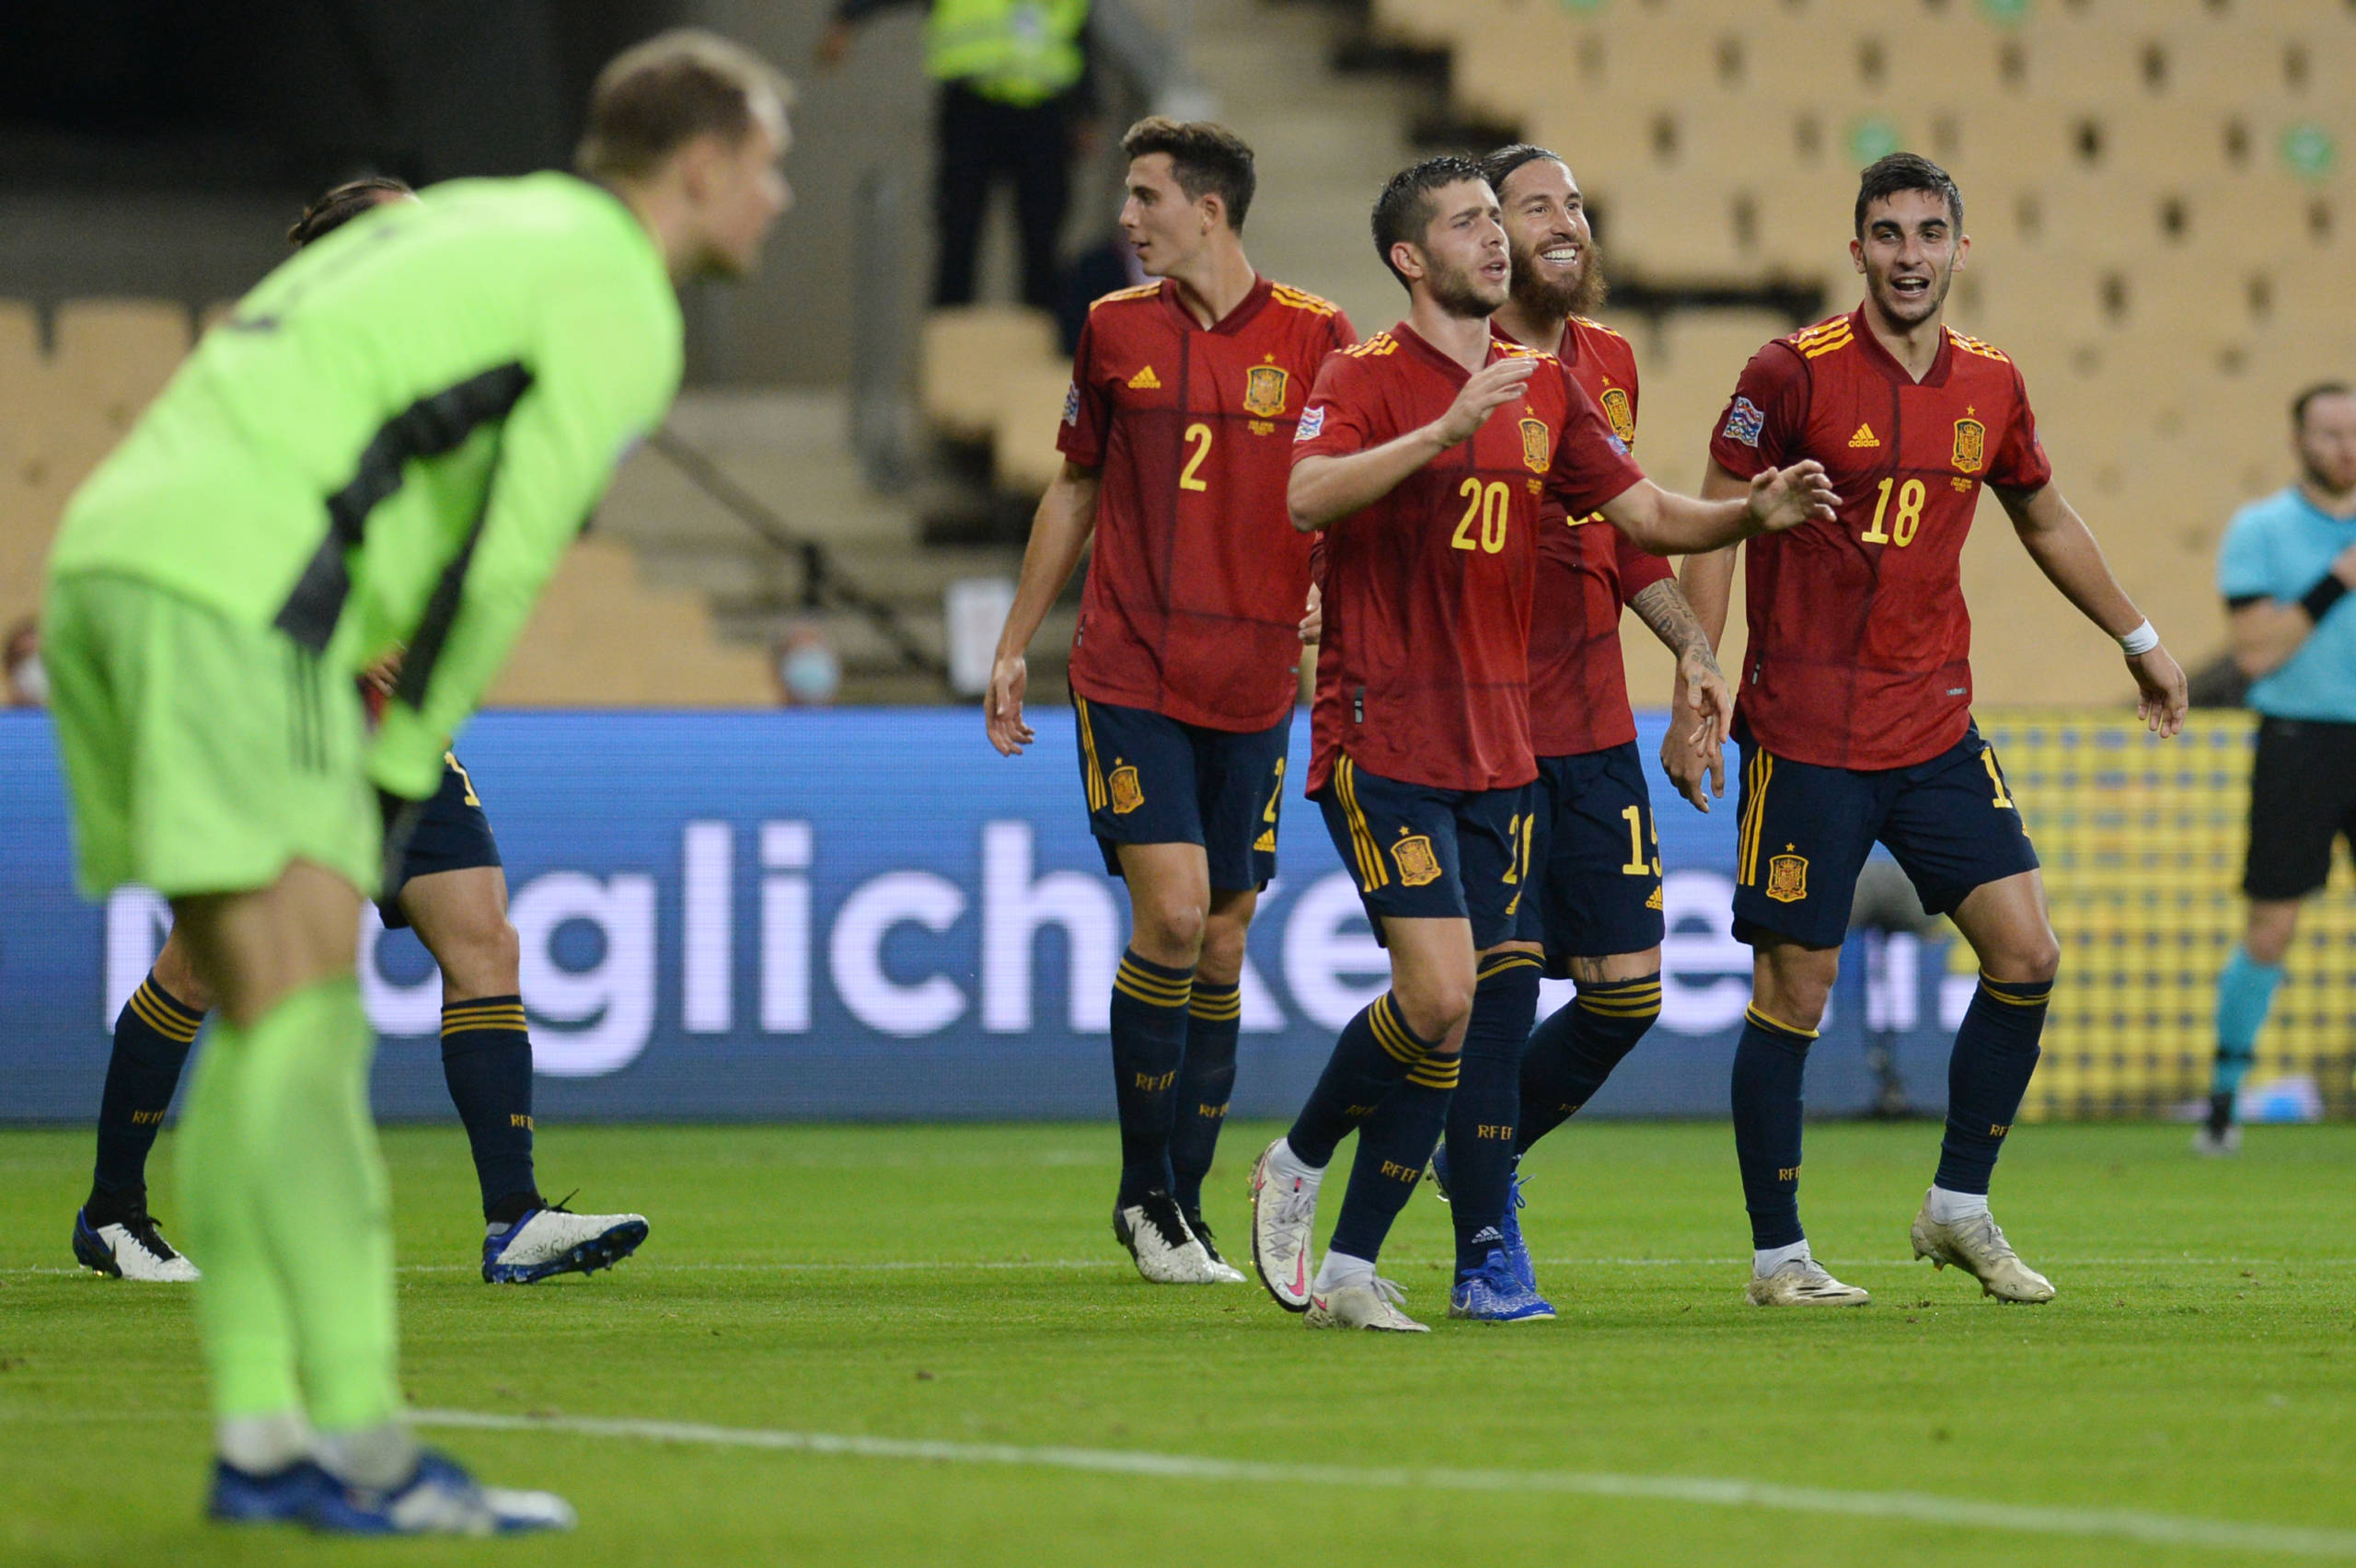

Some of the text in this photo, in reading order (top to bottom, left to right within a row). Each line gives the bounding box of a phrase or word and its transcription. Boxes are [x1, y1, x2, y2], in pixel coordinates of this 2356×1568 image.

[1179, 422, 1213, 491] 2
[1848, 437, 1881, 448] adidas
[1451, 477, 1509, 554] 20
[1861, 477, 1926, 548] 18
[1380, 1159, 1419, 1183] RFEF
